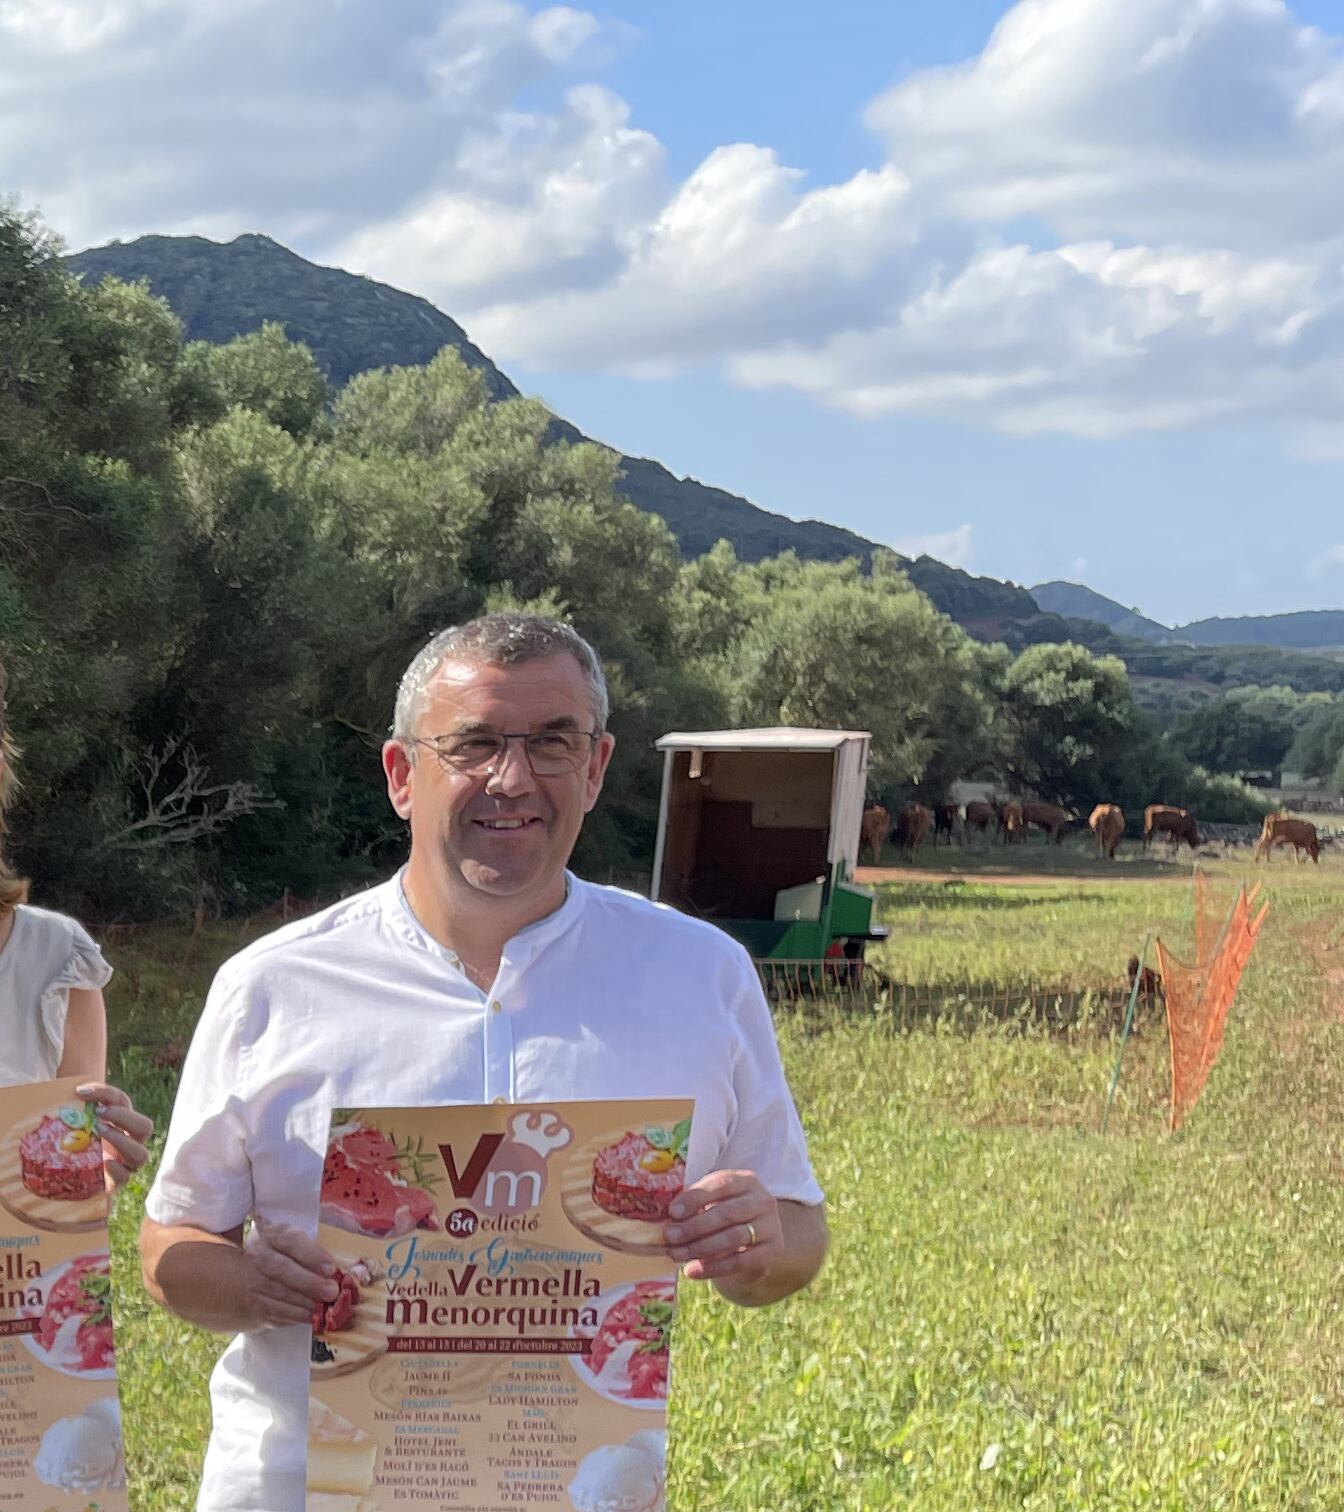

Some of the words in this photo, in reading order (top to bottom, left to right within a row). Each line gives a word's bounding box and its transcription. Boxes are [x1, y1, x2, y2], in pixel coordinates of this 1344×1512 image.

[481, 1214, 541, 1232] edició
[386, 1282, 448, 1296] Vedella
[448, 1265, 600, 1297] Vermella
